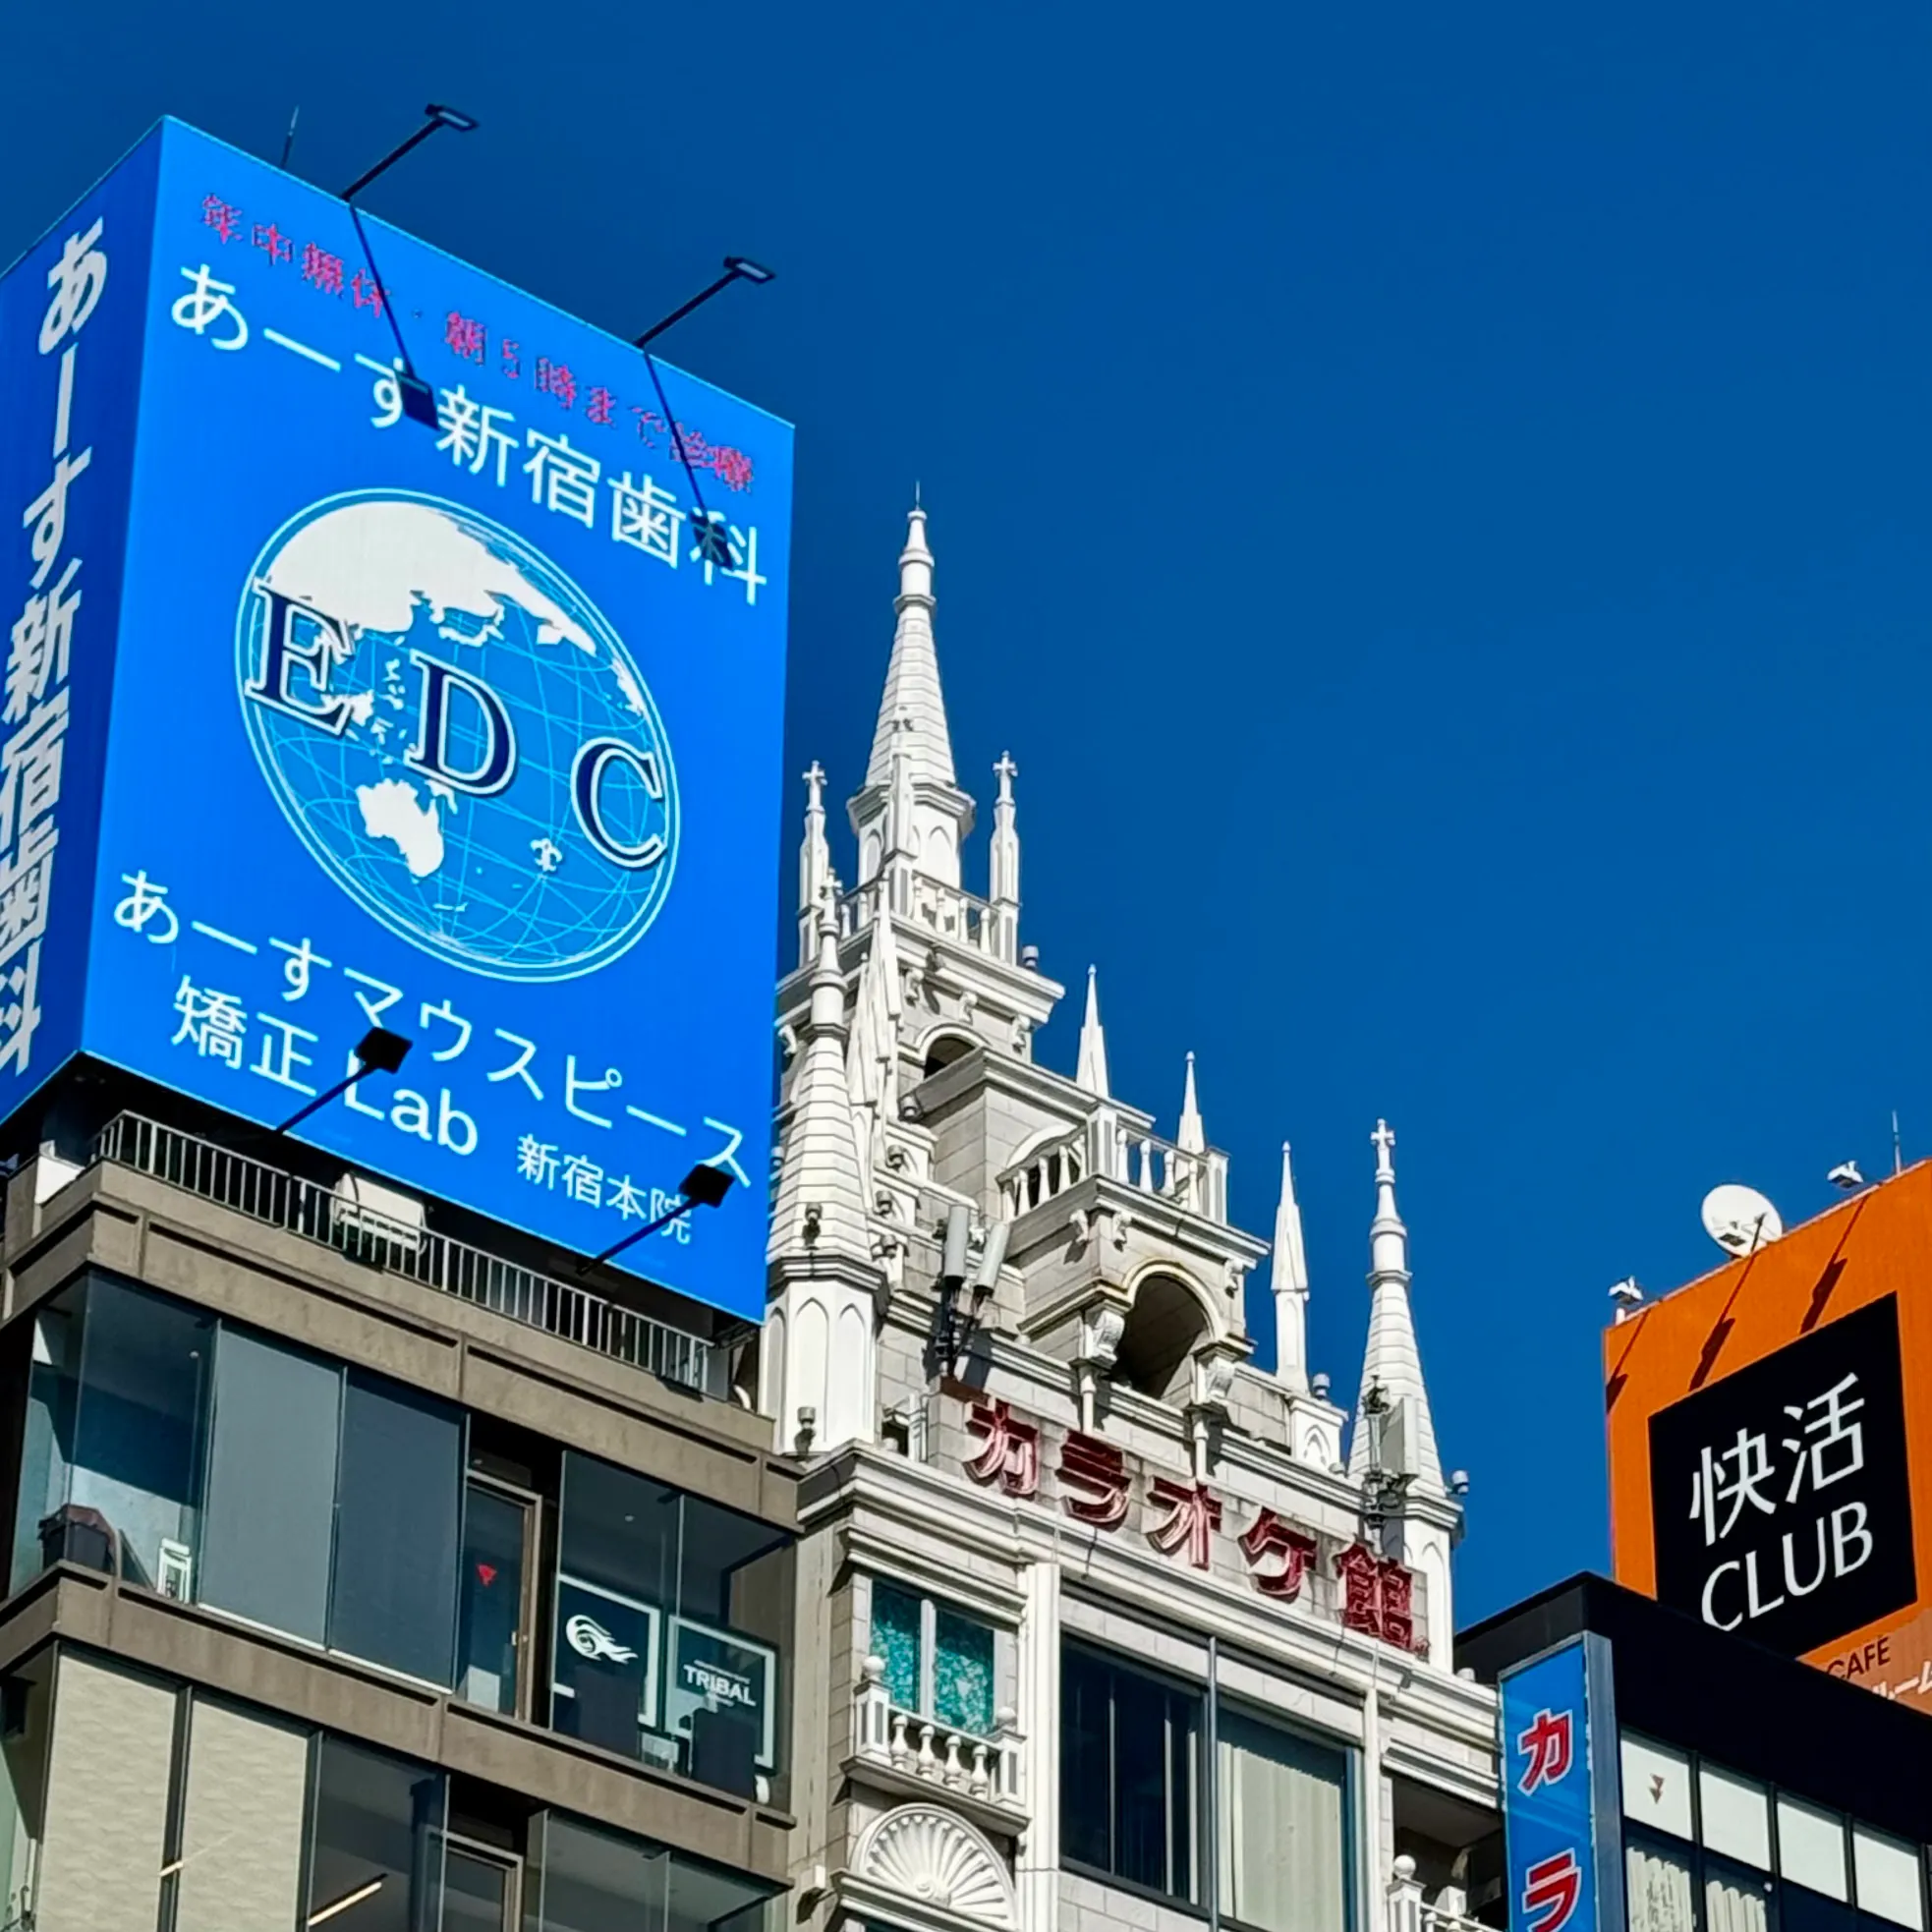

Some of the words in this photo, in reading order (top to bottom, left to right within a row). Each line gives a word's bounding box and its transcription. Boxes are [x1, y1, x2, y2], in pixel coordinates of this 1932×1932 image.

[113, 869, 752, 1189] あーすマウスピース
[517, 1132, 692, 1245] 新宿本院
[962, 1395, 1414, 1655] カラオケ館
[1688, 1372, 1866, 1546] 快活
[1700, 1501, 1874, 1631] CLUB
[683, 1664, 757, 1707] TRIBAL
